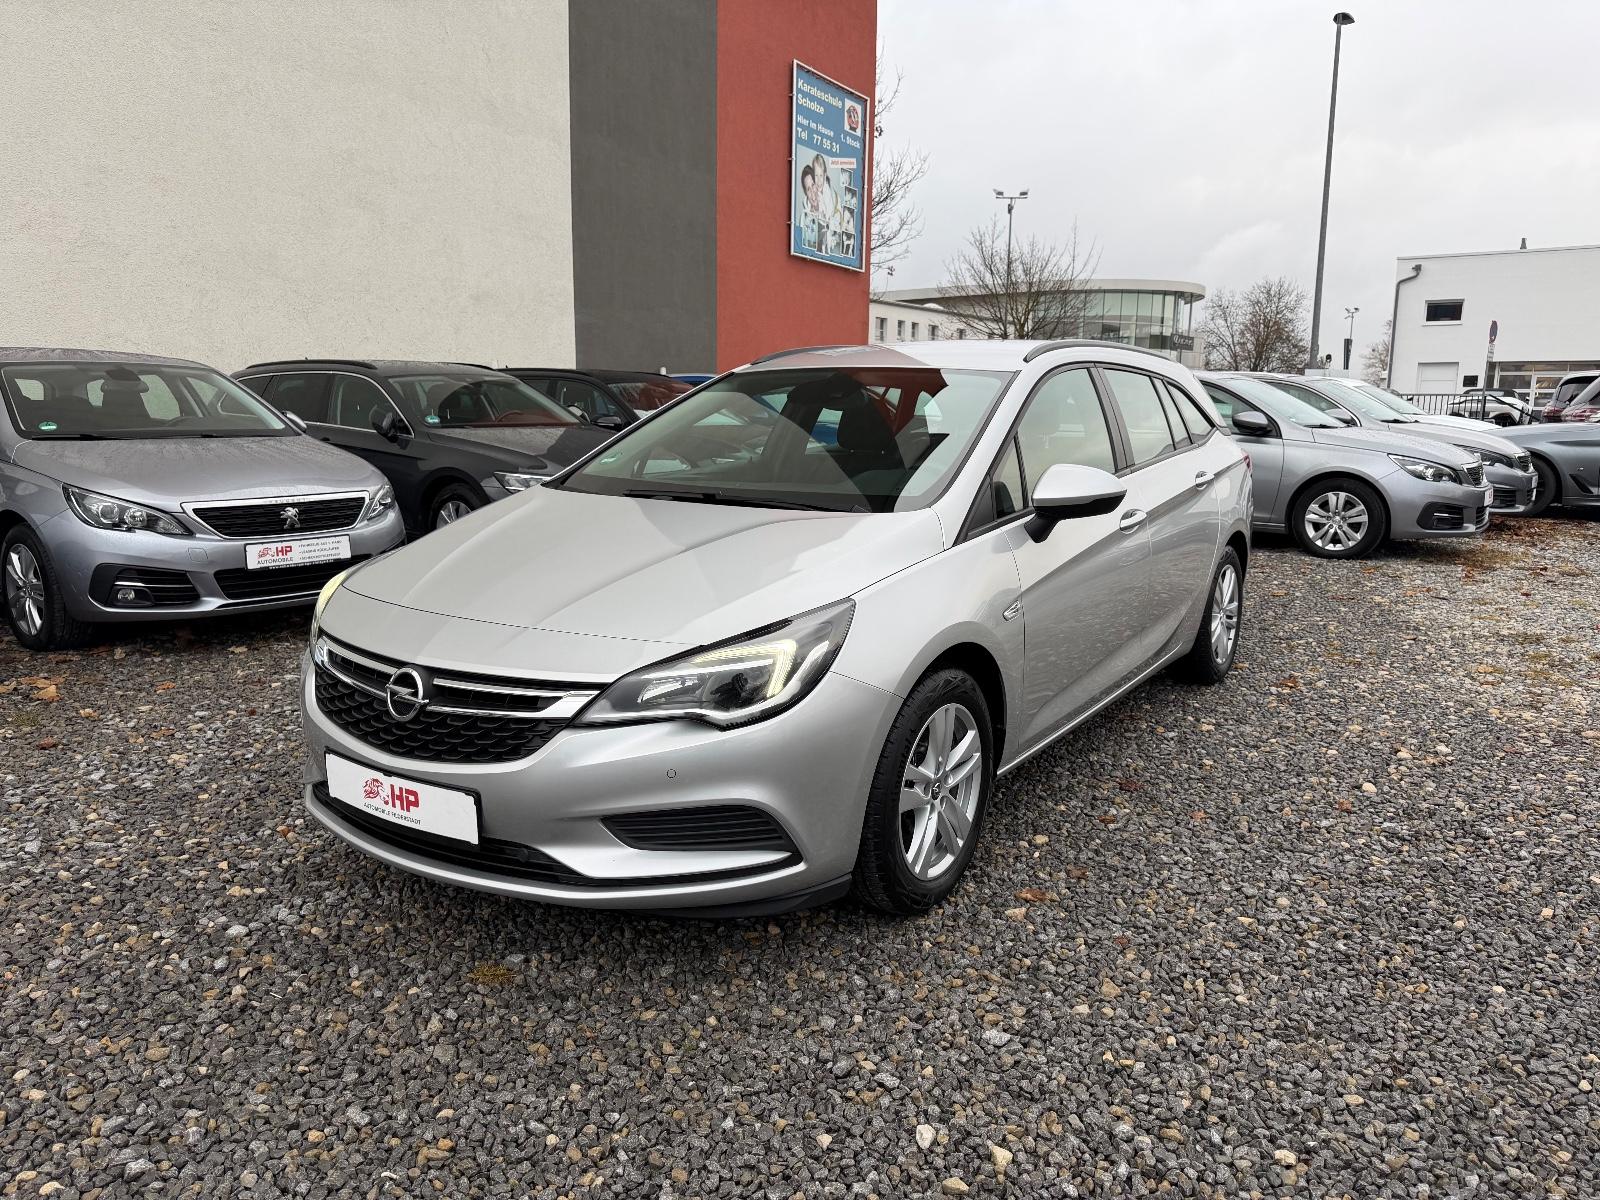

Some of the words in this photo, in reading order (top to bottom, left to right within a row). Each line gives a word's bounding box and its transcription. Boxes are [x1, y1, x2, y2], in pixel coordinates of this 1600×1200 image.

[797, 93, 825, 115] Scholze
[798, 78, 843, 109] Karateschule
[797, 114, 809, 126] Hier
[817, 123, 834, 138] Hause
[846, 136, 860, 149] Stock
[797, 127, 808, 141] Tel
[813, 134, 822, 146] 77
[822, 138, 831, 150] 55
[832, 141, 840, 153] 31
[257, 557, 294, 565] AUTOMOBILE
[275, 546, 293, 557] HP
[363, 802, 391, 817] AUTOMOBILE
[389, 783, 420, 813] HP
